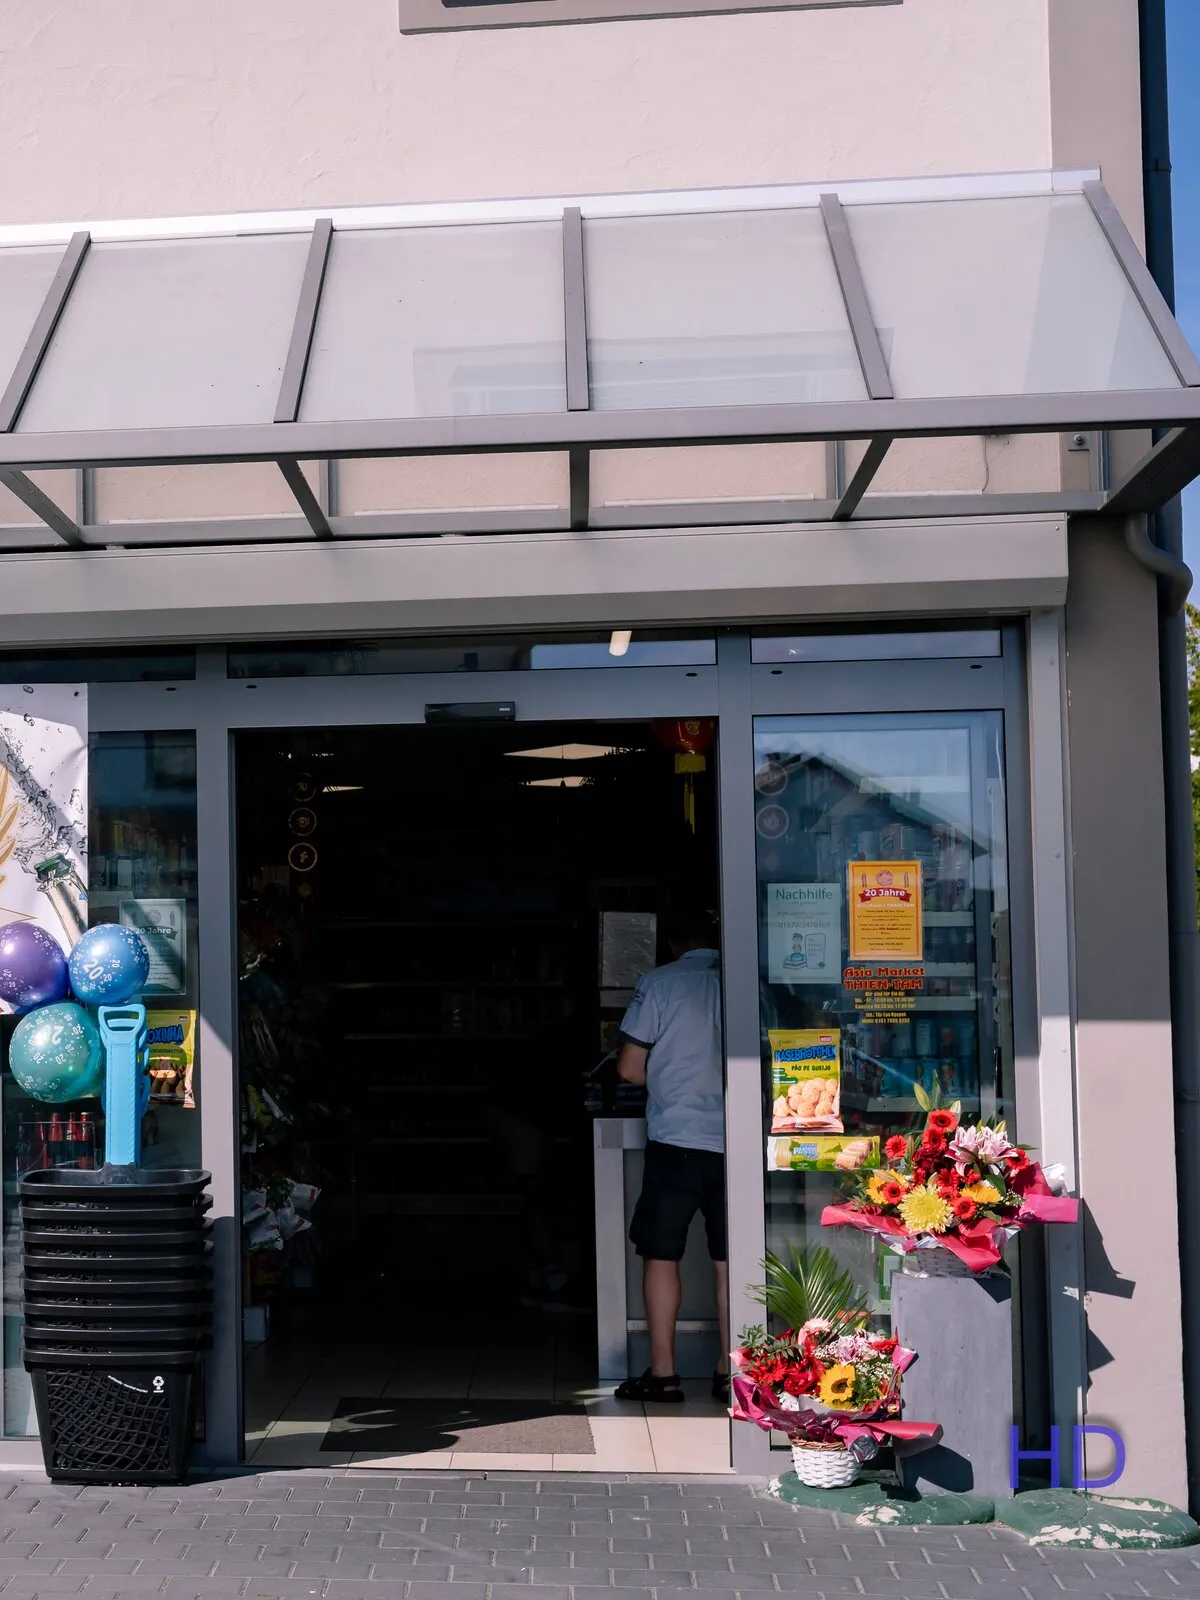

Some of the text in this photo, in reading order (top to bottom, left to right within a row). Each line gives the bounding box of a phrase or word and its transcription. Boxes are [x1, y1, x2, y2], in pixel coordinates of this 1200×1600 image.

[776, 888, 833, 900] Nachhilfe
[83, 958, 104, 980] 20
[844, 967, 925, 977] Asia Market
[844, 979, 923, 990] THIEN-TAM
[73, 1024, 83, 1034] 20
[147, 1024, 184, 1043] OXINHA
[33, 1053, 44, 1064] 20
[56, 1054, 66, 1064] 20
